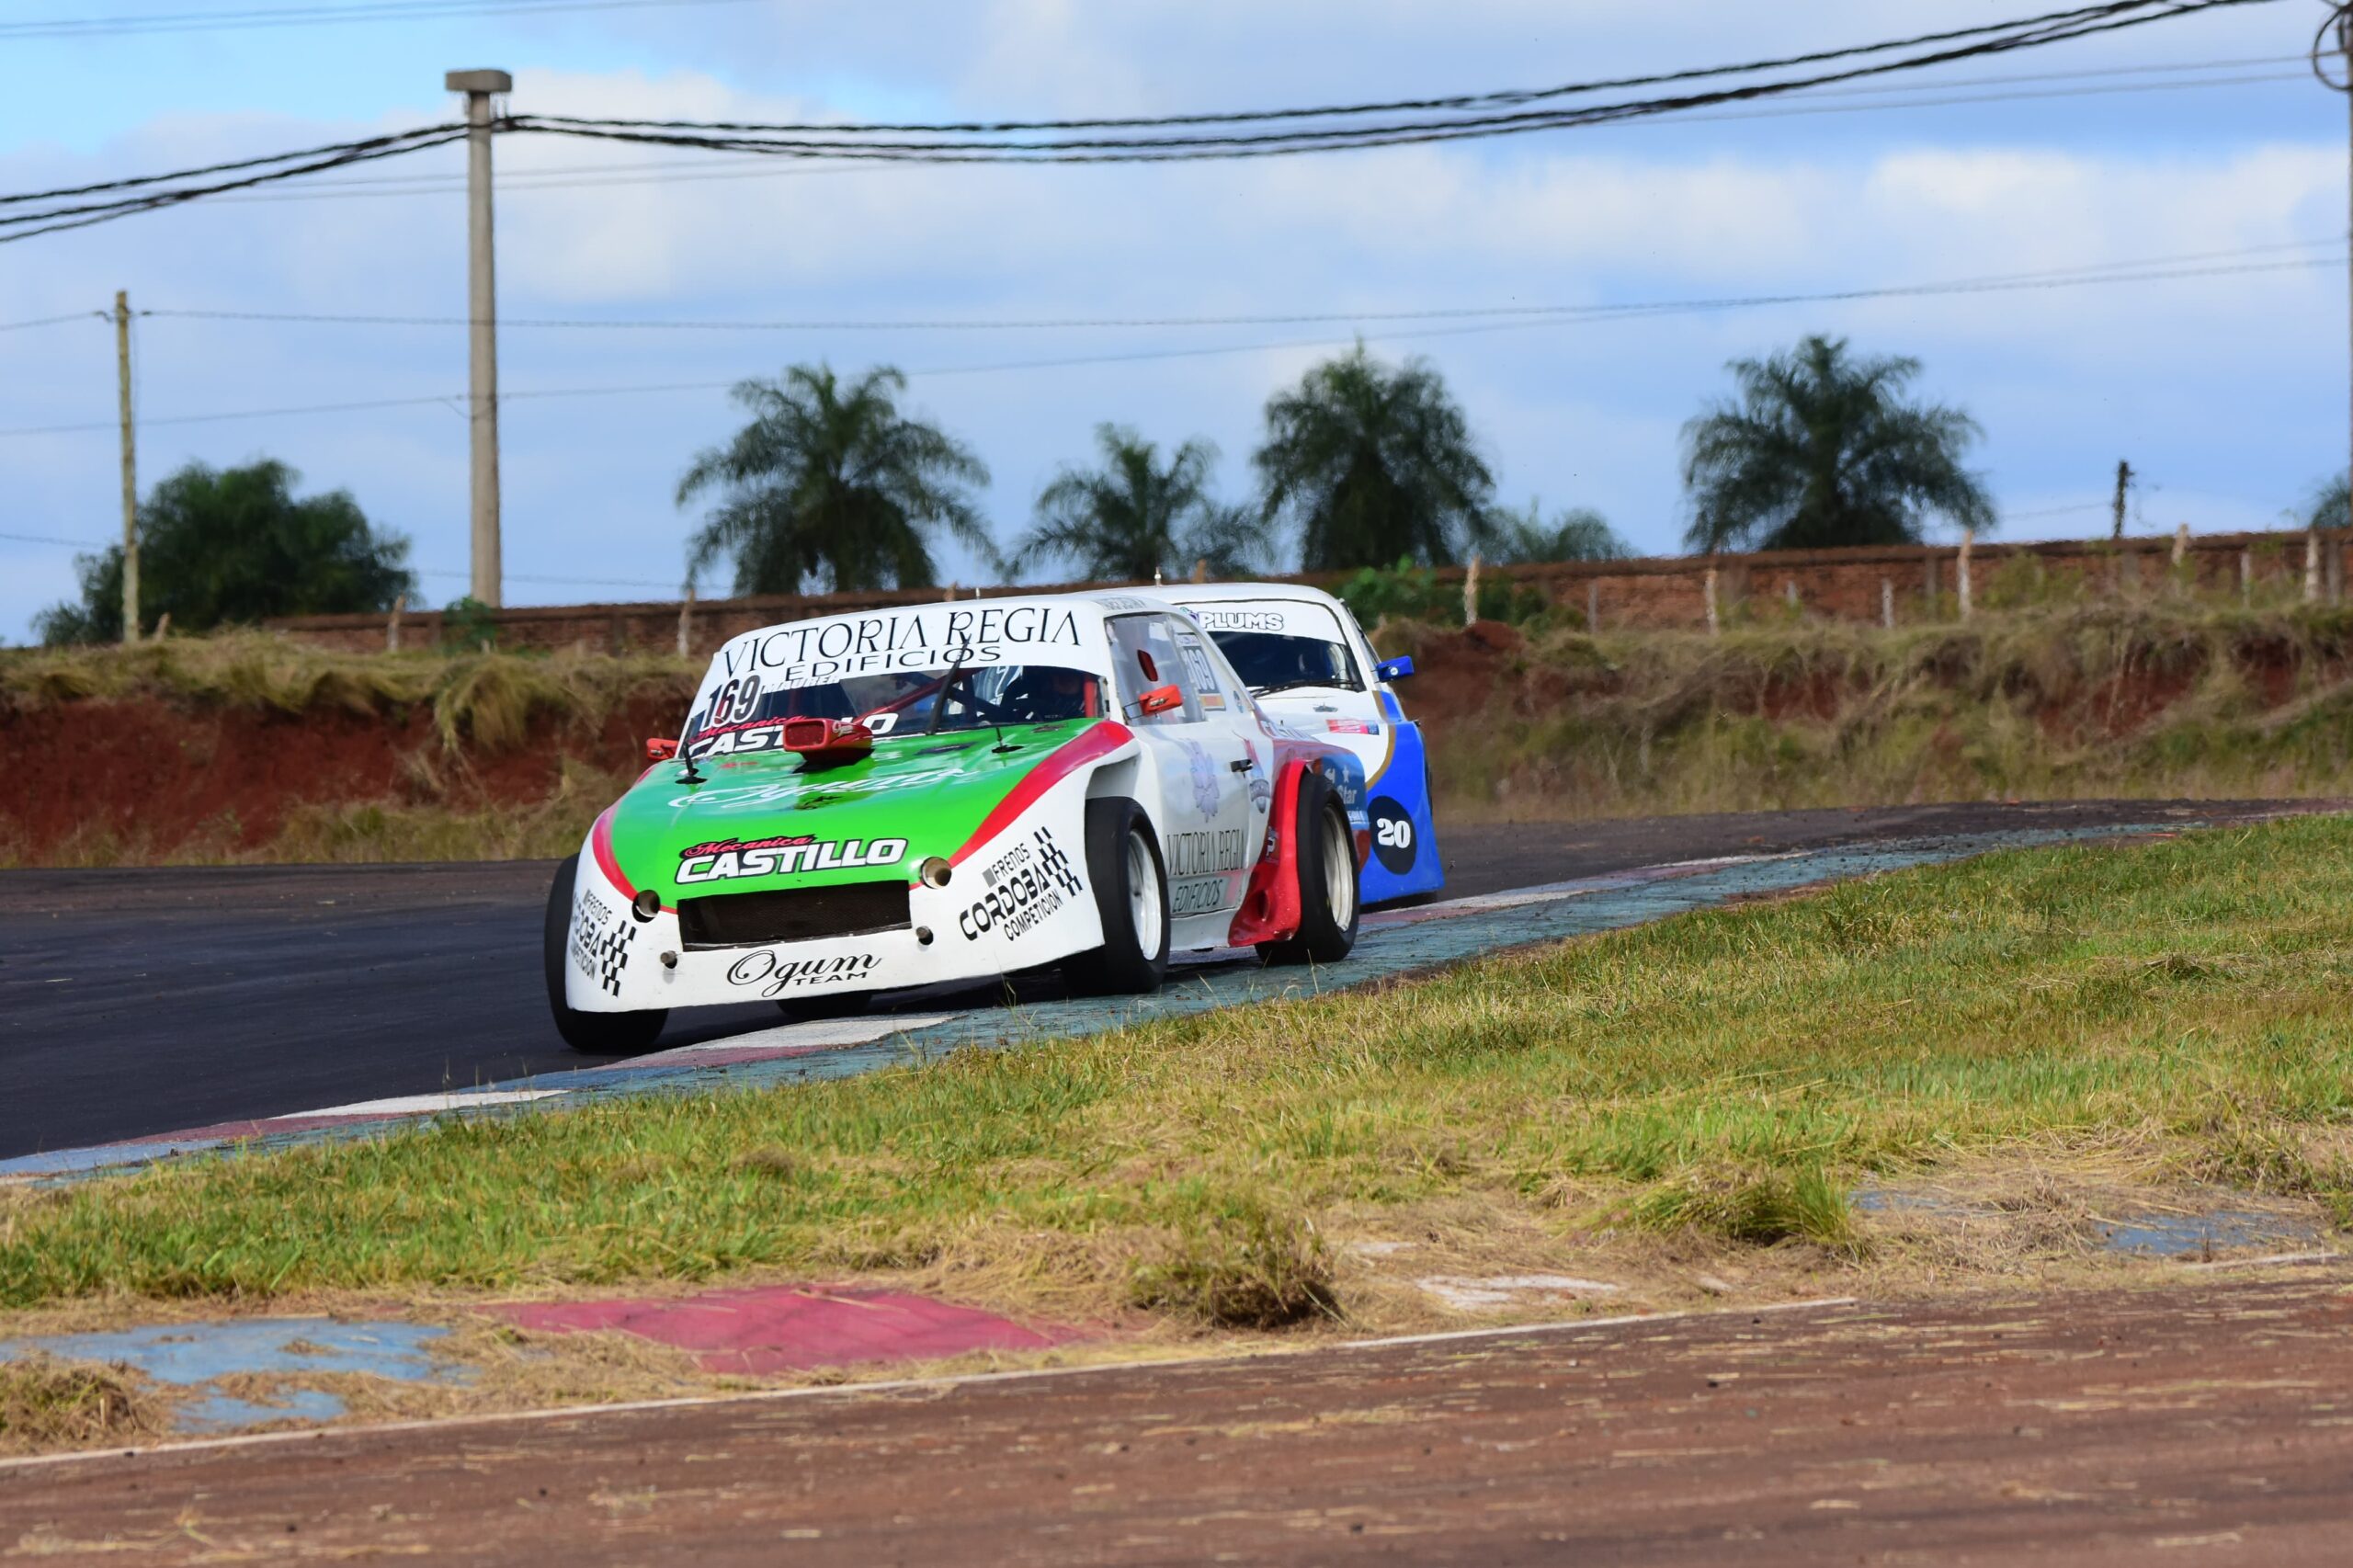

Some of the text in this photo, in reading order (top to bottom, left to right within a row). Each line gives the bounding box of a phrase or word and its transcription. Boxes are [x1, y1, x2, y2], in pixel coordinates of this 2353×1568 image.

[724, 607, 1081, 678] VICTORIA REGIA
[1199, 611, 1284, 631] PLUMS
[785, 646, 1001, 682] EDIFICIOS
[702, 675, 762, 730] 169
[688, 712, 899, 758] CASTO
[1166, 831, 1215, 876] VICTORIA
[1217, 829, 1245, 871] REGIA
[1376, 817, 1411, 848] 20
[676, 839, 906, 883] CASTILLO
[992, 843, 1030, 881] FRENOS
[960, 863, 1051, 941] CORDOBA
[1004, 889, 1063, 941] COMPETICION
[1172, 879, 1223, 913] EDIFICIOS
[727, 949, 882, 997] Ogum
[794, 971, 868, 986] TEAM
